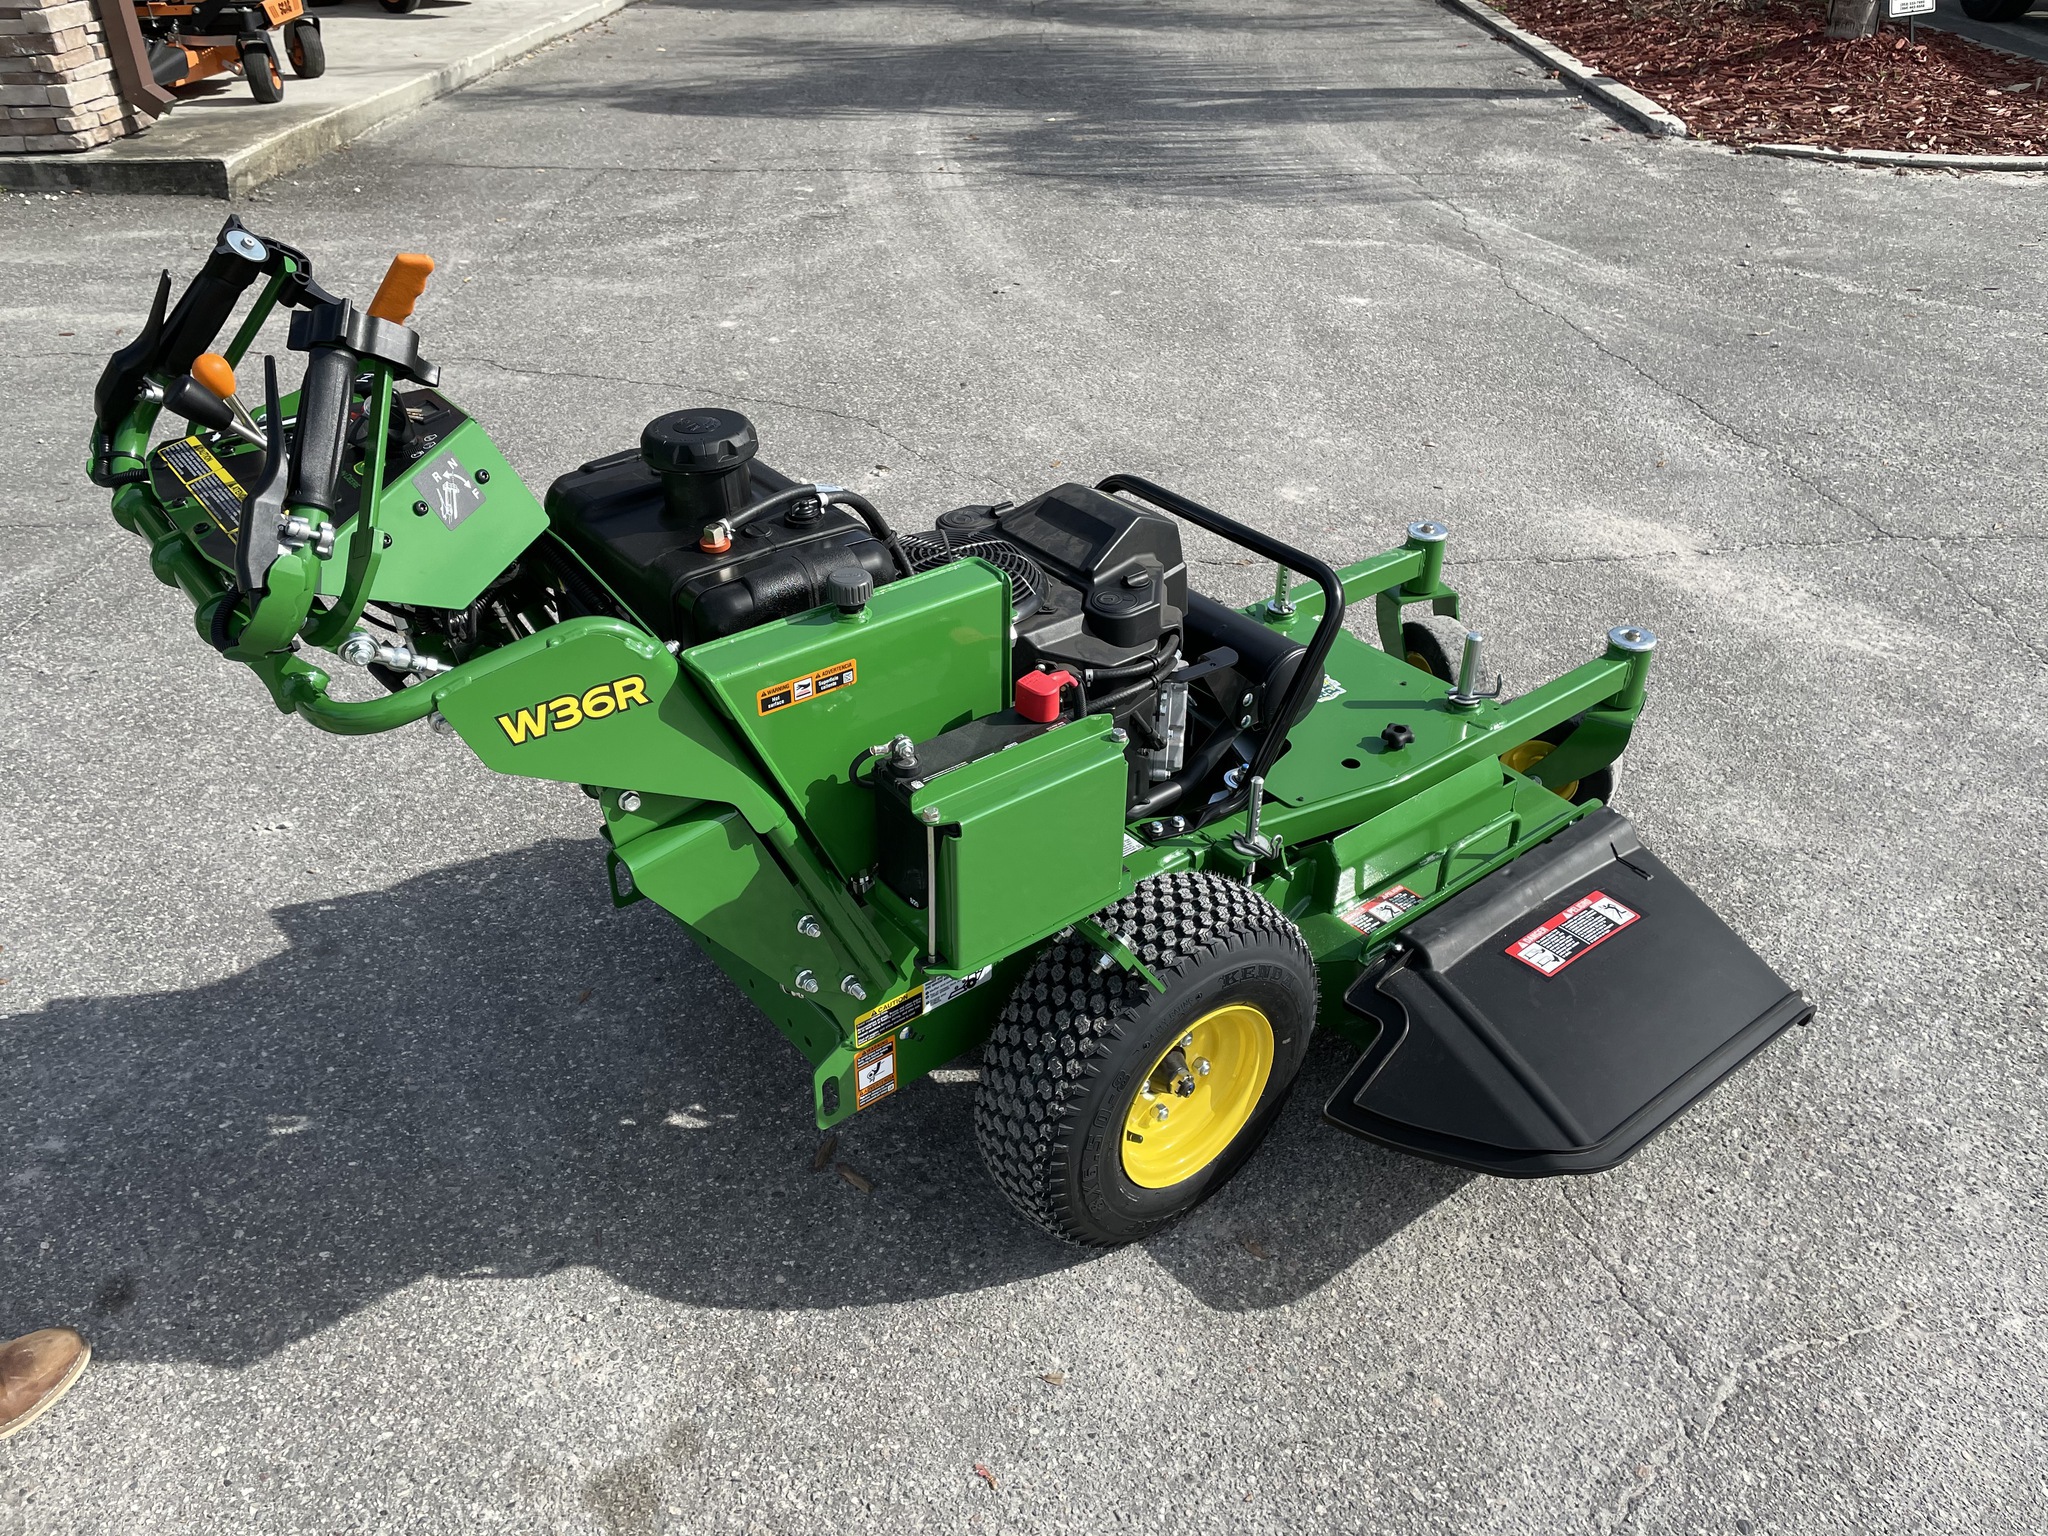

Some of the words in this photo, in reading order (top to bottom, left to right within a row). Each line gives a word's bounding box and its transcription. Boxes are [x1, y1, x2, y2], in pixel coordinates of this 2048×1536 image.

[447, 458, 459, 470] N
[431, 471, 443, 483] R
[471, 488, 481, 500] F
[821, 662, 852, 677] ADVERTENCIA
[766, 683, 790, 695] WARNING
[495, 675, 652, 745] W36R
[1218, 964, 1297, 992] KENDA
[877, 993, 909, 1014] CAUTION
